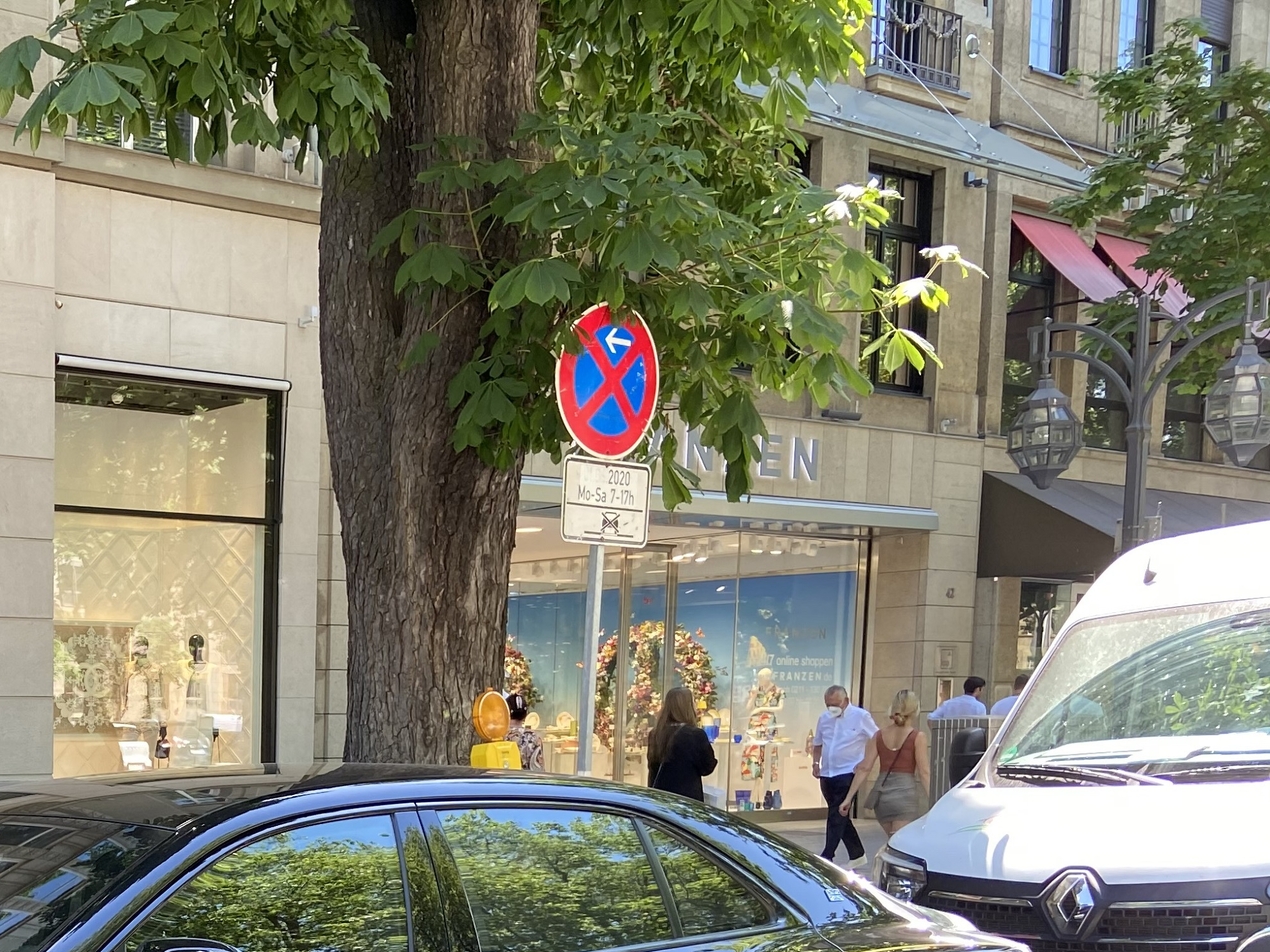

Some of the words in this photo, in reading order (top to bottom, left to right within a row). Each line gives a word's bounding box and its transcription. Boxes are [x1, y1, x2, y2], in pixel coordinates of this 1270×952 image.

[608, 469, 631, 486] 2020
[577, 485, 607, 503] Mo-Sa
[610, 488, 635, 506] 7-17h
[776, 655, 800, 666] online
[800, 655, 833, 668] shoppen
